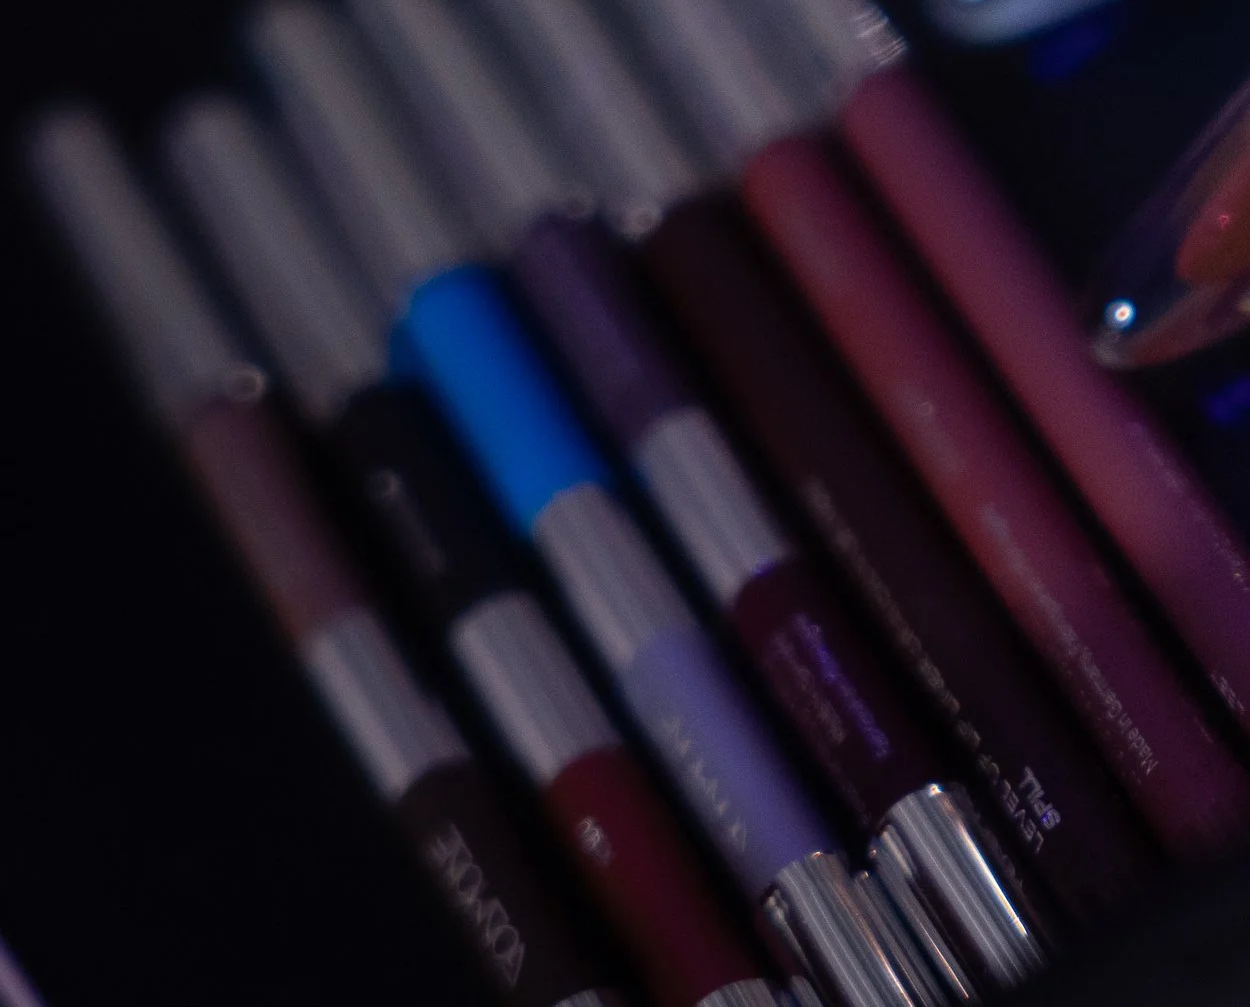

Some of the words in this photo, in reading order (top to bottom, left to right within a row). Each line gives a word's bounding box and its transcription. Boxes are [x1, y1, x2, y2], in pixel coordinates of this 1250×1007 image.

[1120, 726, 1161, 776] Made
[994, 777, 1048, 854] LEVEL
[1011, 763, 1063, 832] SPILL
